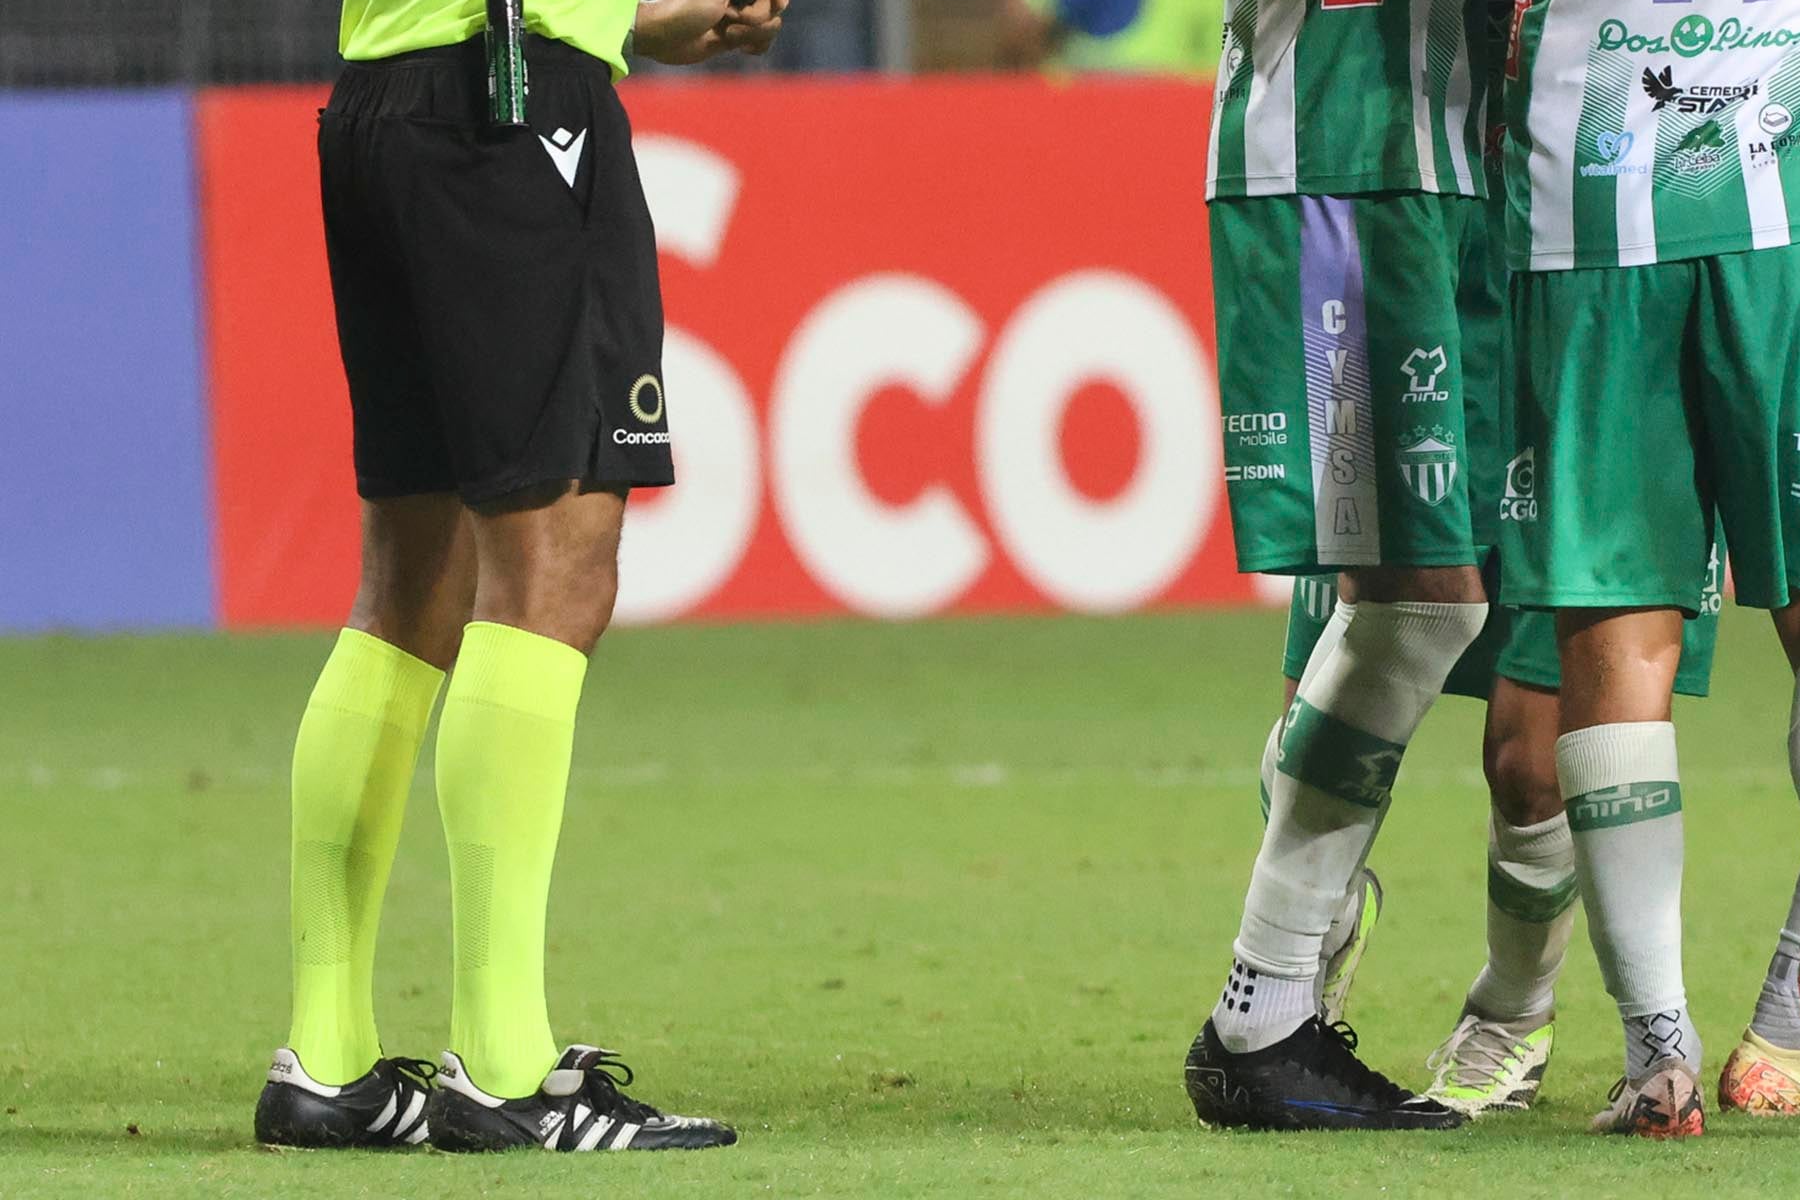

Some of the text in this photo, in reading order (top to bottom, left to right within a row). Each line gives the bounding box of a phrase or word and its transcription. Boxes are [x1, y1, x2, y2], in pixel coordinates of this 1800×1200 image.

[1597, 18, 1670, 53] Dos
[1749, 142, 1767, 154] LA
[1221, 412, 1287, 432] TECNO
[1322, 299, 1361, 535] CYMSA
[1243, 464, 1286, 480] ISDIN
